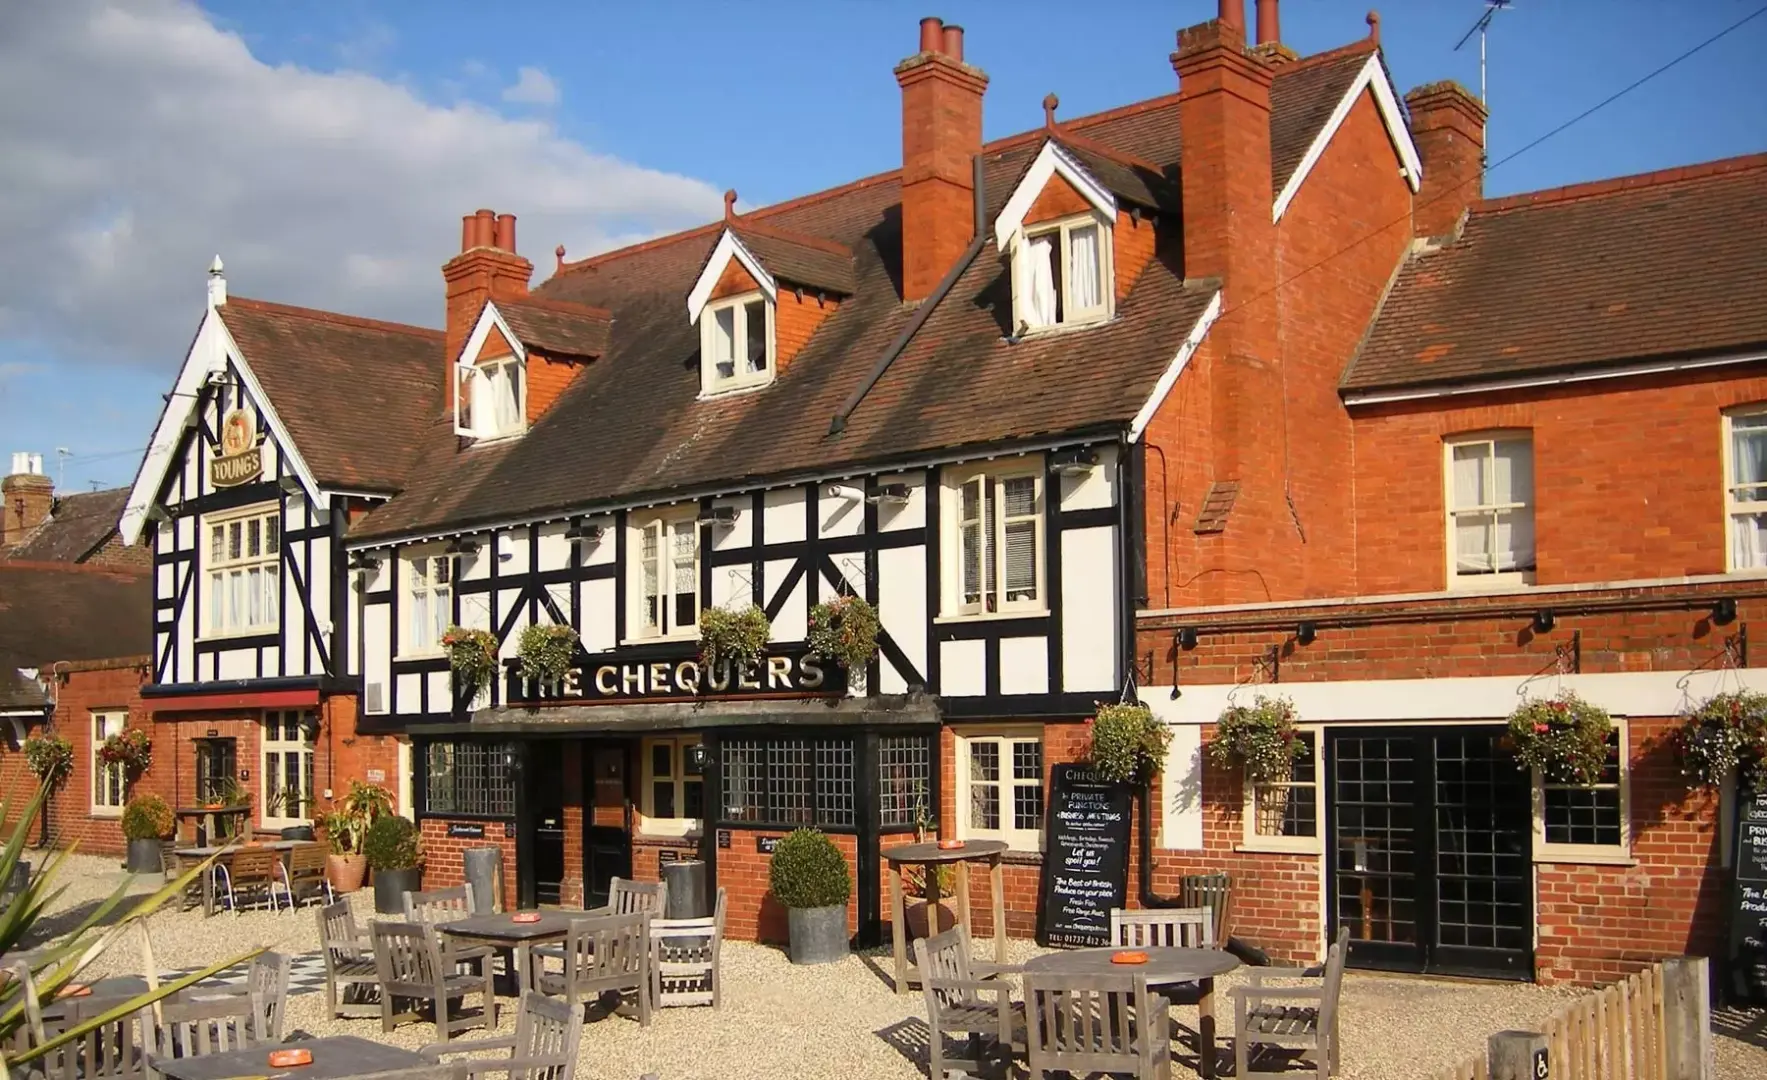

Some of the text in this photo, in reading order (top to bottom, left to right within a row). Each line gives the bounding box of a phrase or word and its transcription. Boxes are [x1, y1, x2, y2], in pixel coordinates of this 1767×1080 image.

[214, 453, 259, 480] YOUNG'S
[516, 652, 824, 698] THE CHEQUERS
[1071, 792, 1105, 801] PRIVATE
[1072, 848, 1084, 857] Let
[1065, 856, 1083, 866] spoil
[1068, 878, 1083, 887] Best
[1062, 906, 1076, 914] Free
[1064, 934, 1085, 944] 01737
[1100, 938, 1112, 947] 36
